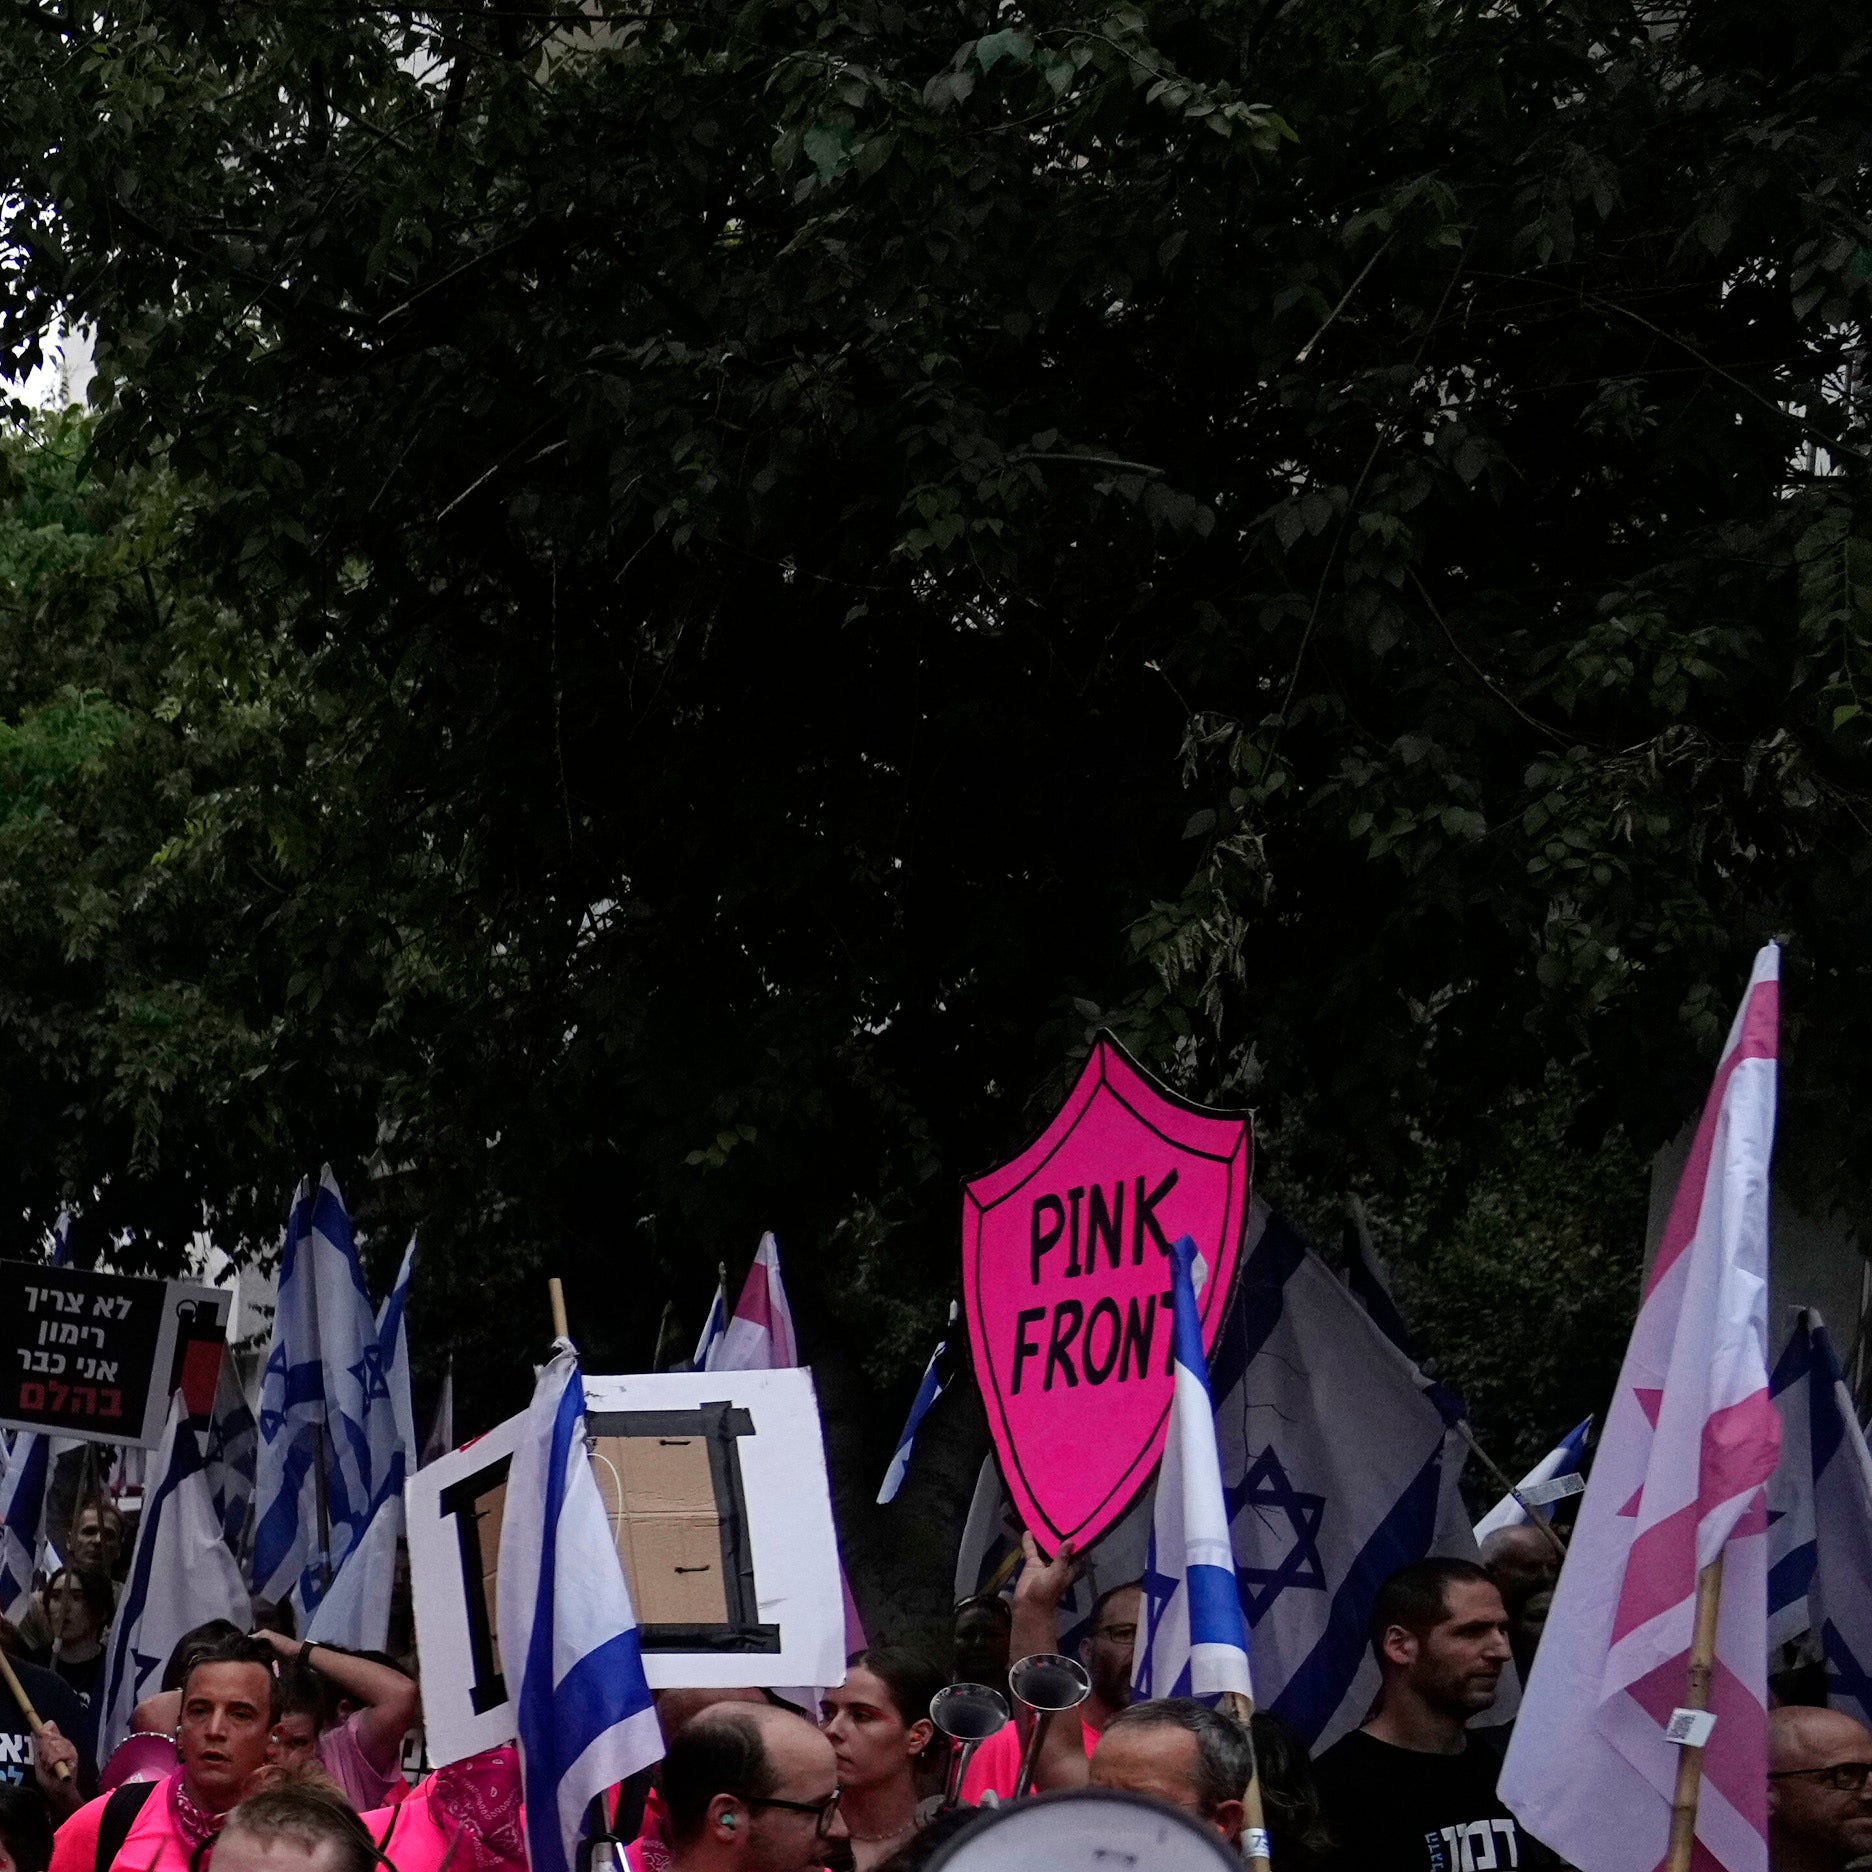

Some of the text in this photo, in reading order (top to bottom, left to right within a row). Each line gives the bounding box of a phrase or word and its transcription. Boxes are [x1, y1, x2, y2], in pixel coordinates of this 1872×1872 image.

[1026, 1162, 1183, 1291] PINK
[24, 1286, 132, 1320] לא צריך
[38, 1320, 105, 1349] רימון
[1011, 1285, 1181, 1395] FRONT
[17, 1348, 118, 1383] אני כבר
[19, 1380, 122, 1417] בהלם
